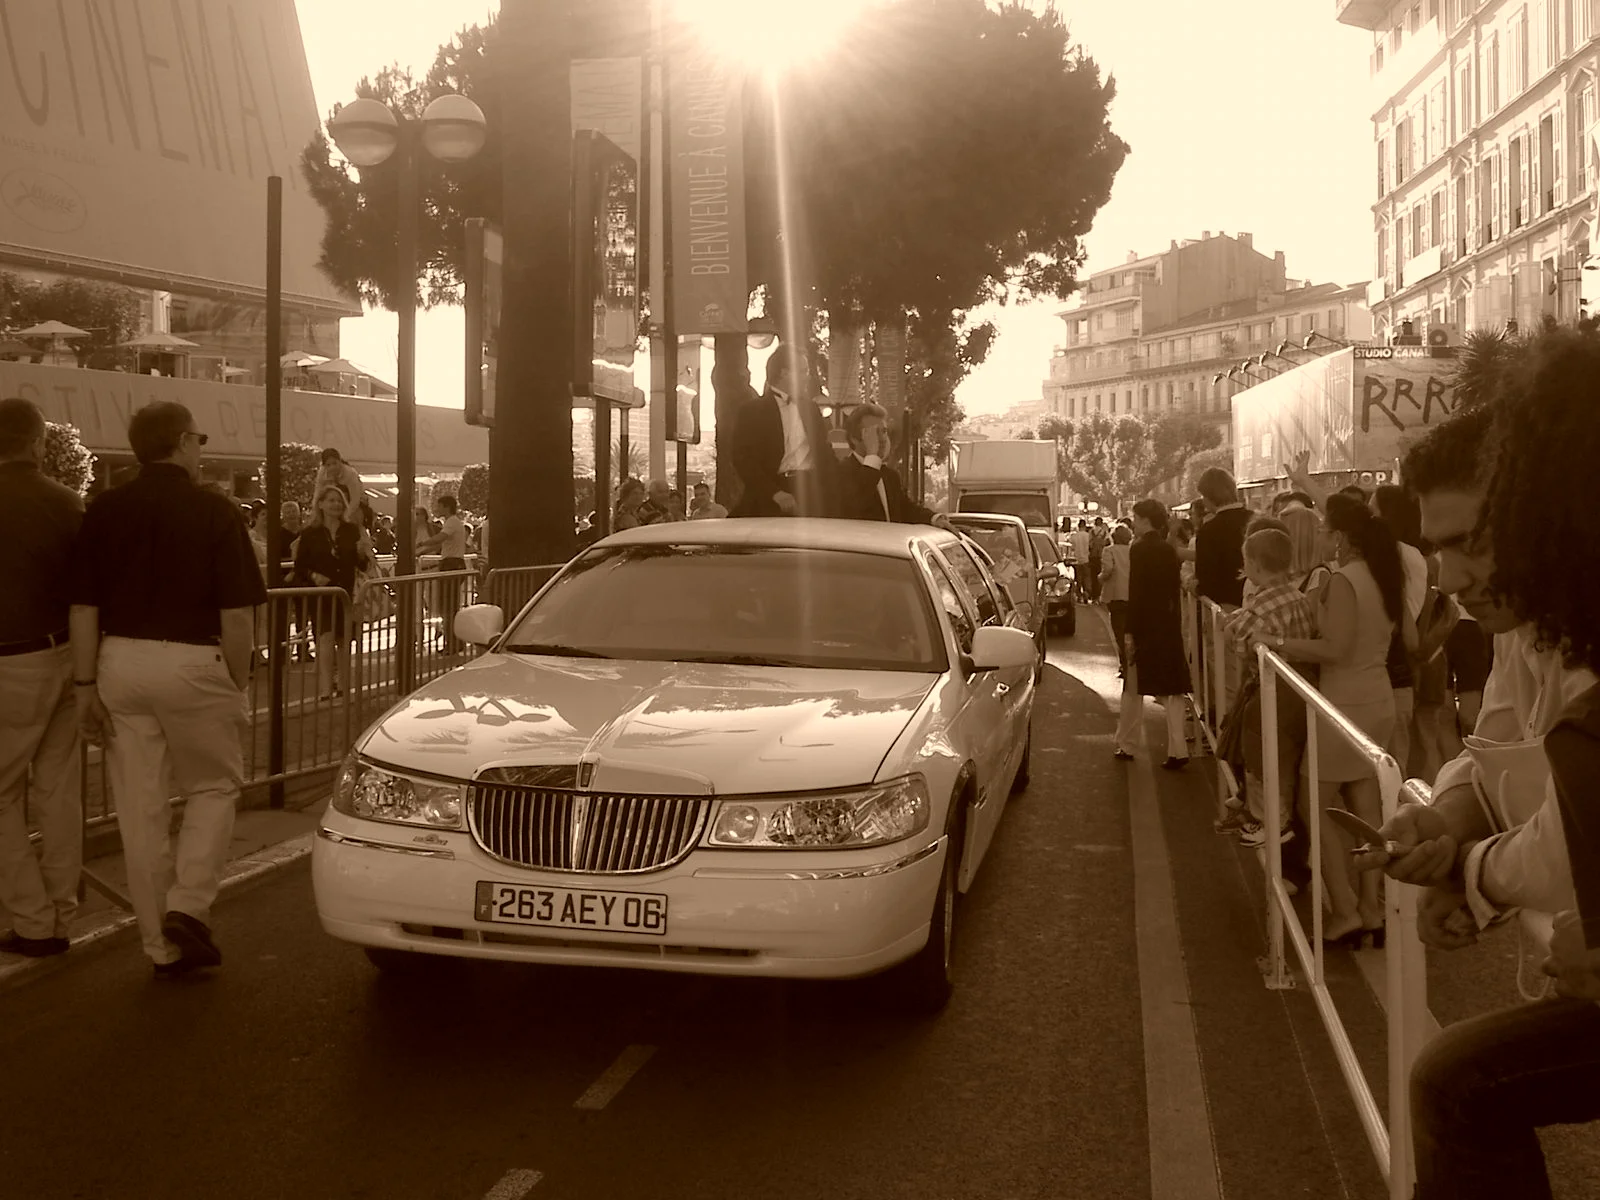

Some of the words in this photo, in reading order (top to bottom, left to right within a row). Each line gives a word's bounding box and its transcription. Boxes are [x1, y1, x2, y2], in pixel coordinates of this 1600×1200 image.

[677, 144, 727, 158] À
[688, 166, 730, 276] BIENVENUE
[1354, 347, 1393, 359] STUDIO
[1394, 347, 1430, 358] CANAL
[289, 406, 436, 451] CANNS
[498, 888, 554, 921] 263
[560, 893, 617, 926] AEY
[623, 897, 662, 929] 06
